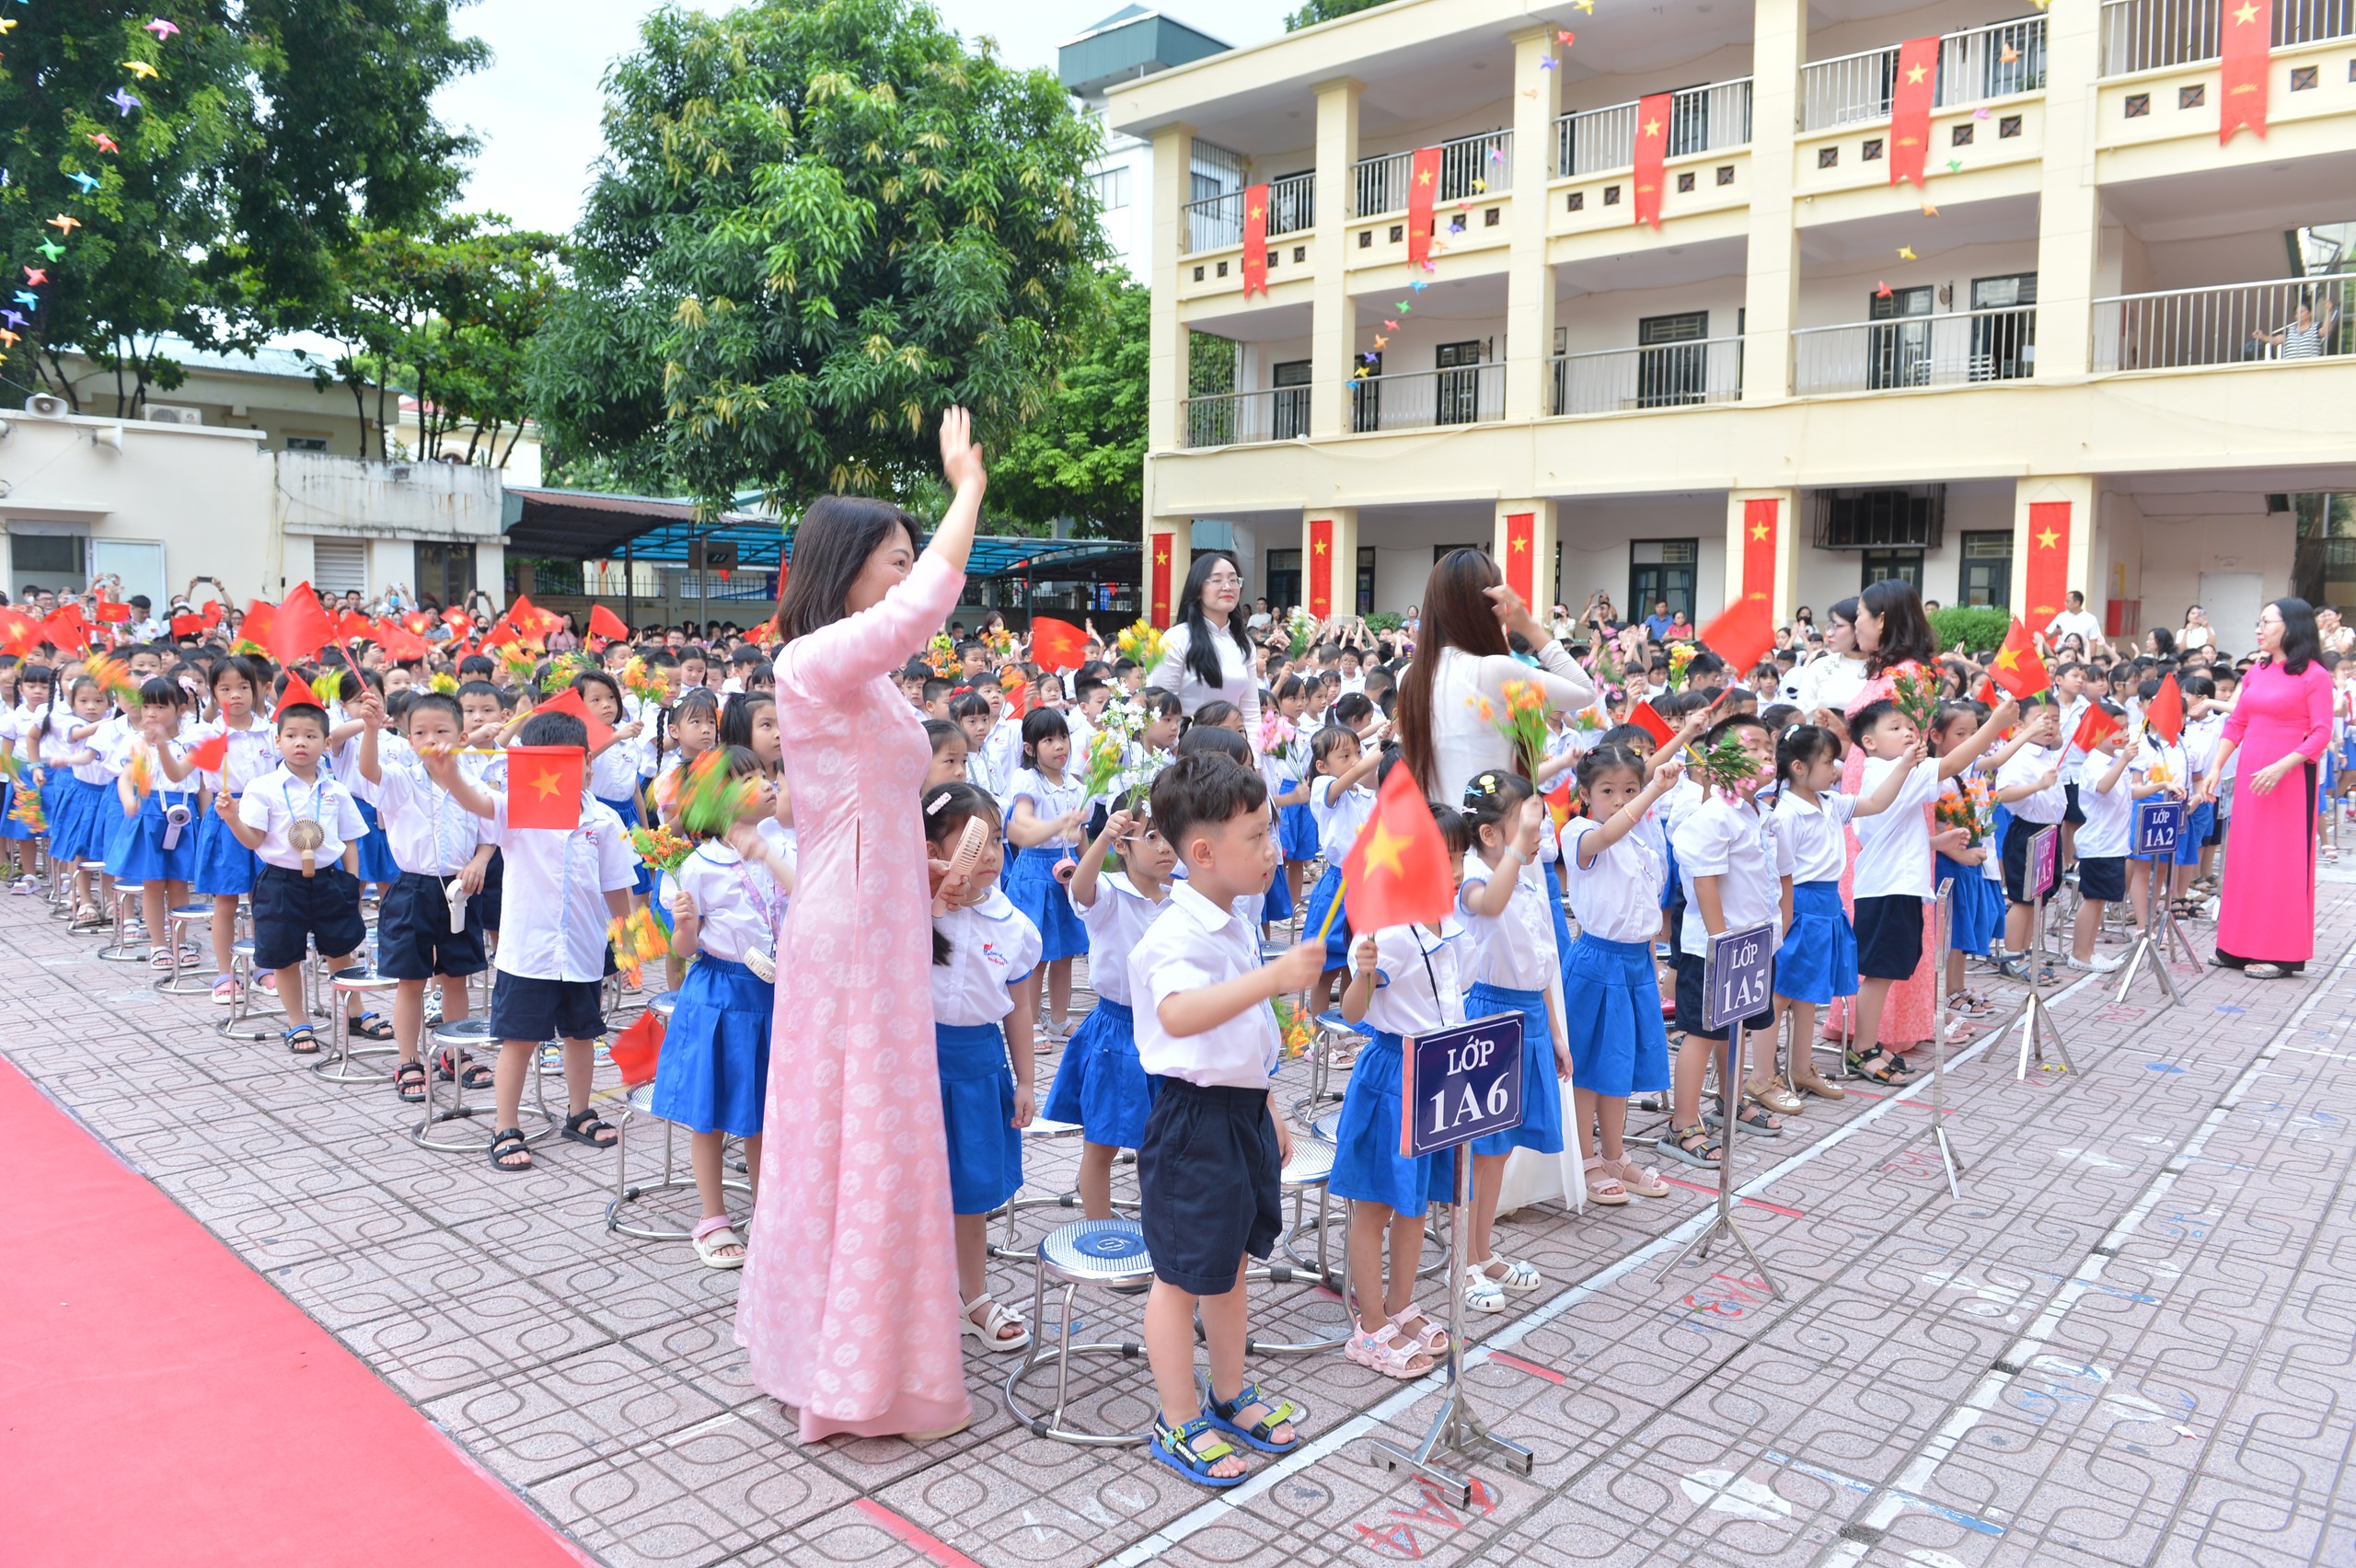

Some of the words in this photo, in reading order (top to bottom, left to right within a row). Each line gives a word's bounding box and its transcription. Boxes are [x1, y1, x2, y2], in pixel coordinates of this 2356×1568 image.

[2153, 809, 2170, 824] LỚP
[2145, 827, 2174, 847] 1A2
[2035, 859, 2052, 888] 1A3
[1731, 940, 1758, 969] LỚP
[1722, 969, 1765, 1013] 1A5
[1447, 1035, 1495, 1076] LỚP
[1429, 1072, 1509, 1134] 1A6
[1175, 1442, 1197, 1463] BATMAN
